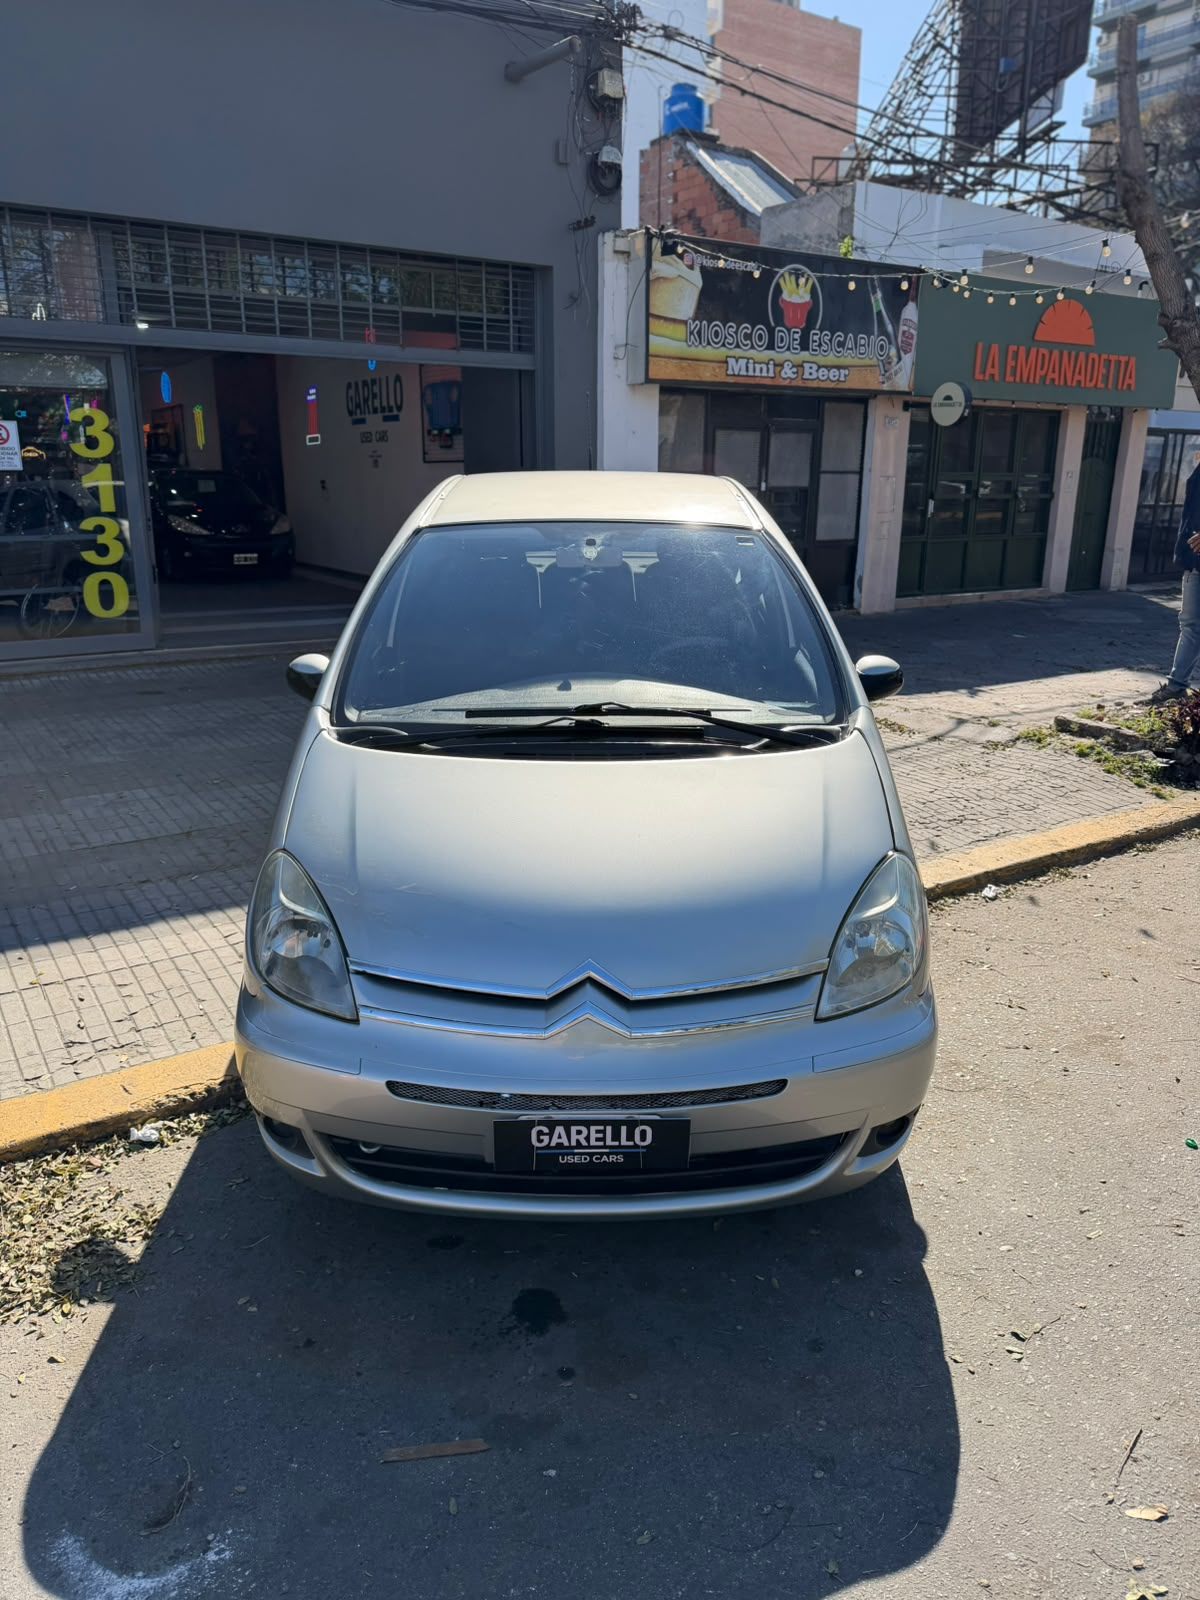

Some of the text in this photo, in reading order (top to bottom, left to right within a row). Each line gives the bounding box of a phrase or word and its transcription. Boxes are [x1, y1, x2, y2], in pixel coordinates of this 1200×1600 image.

[687, 319, 769, 351] KIOSCO
[774, 327, 801, 352] DE
[808, 329, 889, 360] ESCABIO
[727, 357, 849, 382] Mini & Beer
[974, 342, 1136, 391] LA EMPANADETTA
[346, 374, 403, 417] GARELLO
[360, 431, 373, 443] USED
[69, 407, 130, 619] 3130
[530, 1125, 653, 1147] GARELLO
[559, 1155, 590, 1163] USED
